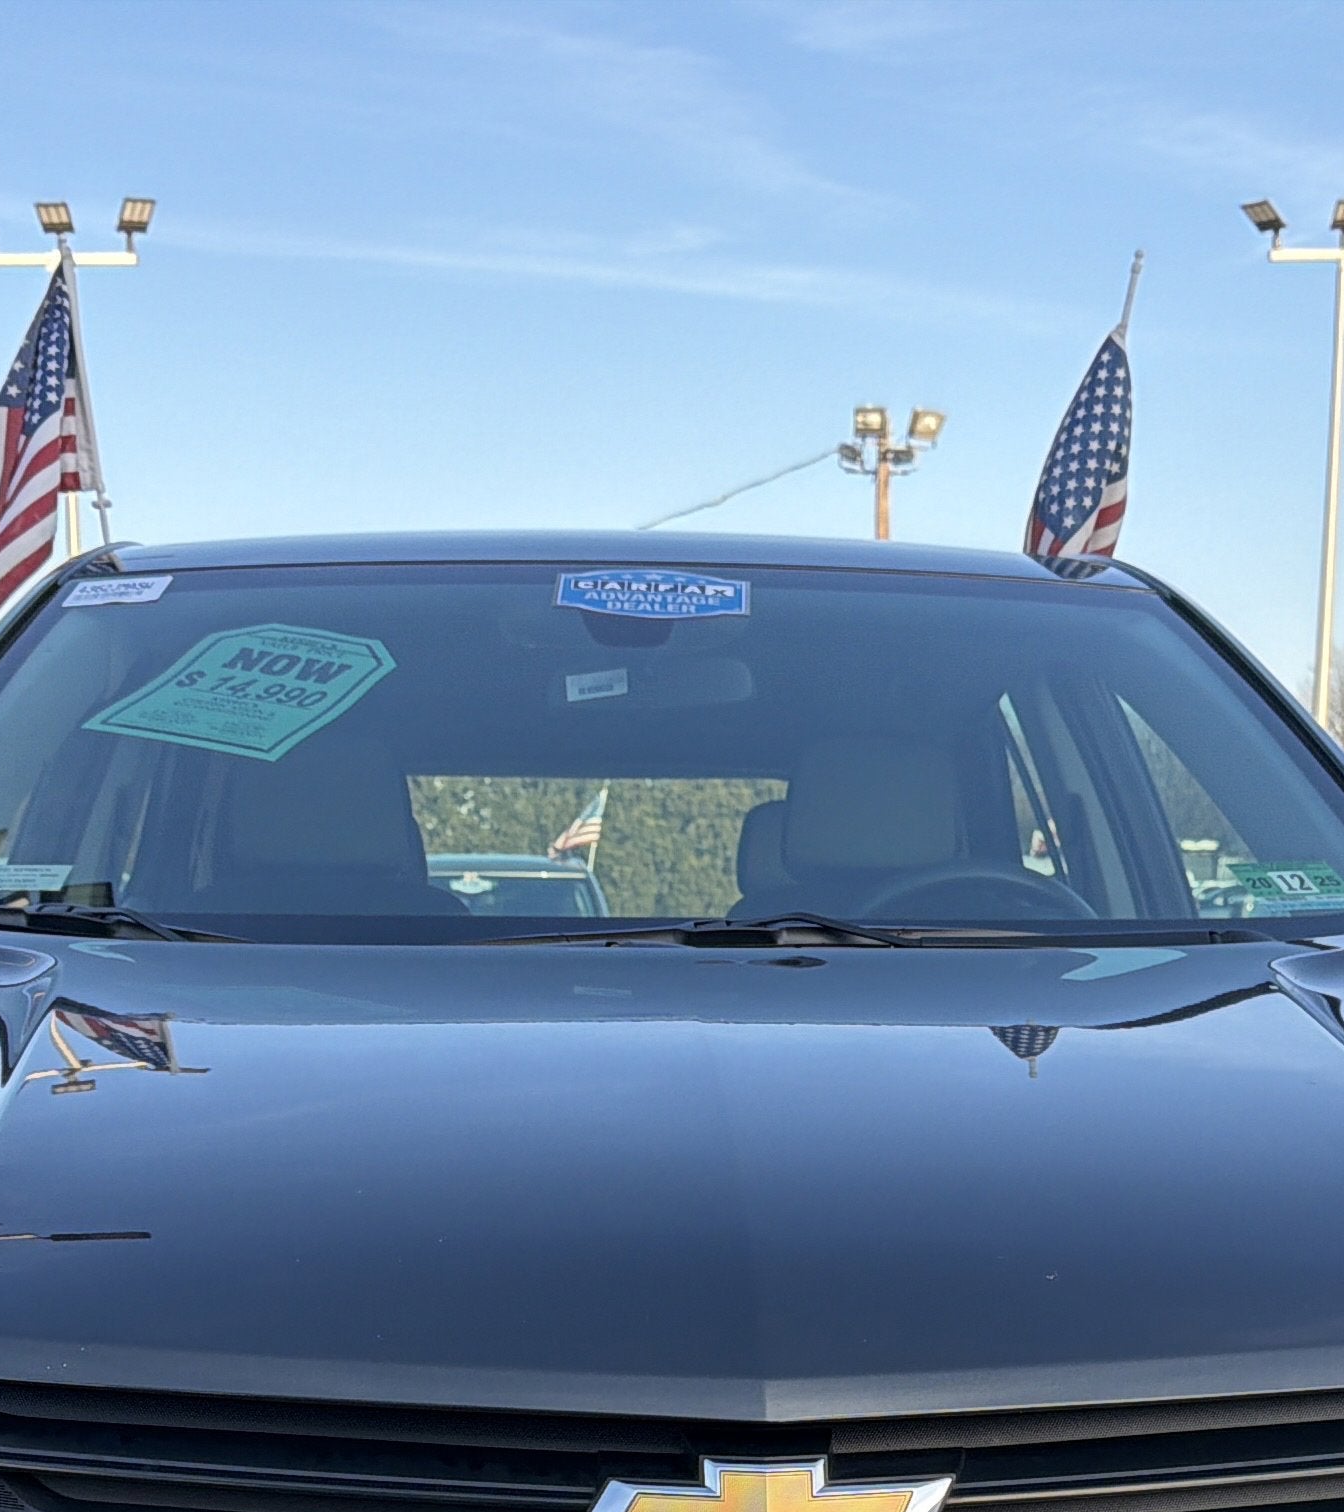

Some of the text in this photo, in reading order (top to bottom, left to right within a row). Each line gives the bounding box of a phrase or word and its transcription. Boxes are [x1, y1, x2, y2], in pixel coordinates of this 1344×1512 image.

[574, 579, 734, 597] CARFAX
[584, 591, 721, 606] ADVANTAGE
[606, 601, 697, 614] DEALER
[220, 646, 354, 685] NOW
[1246, 876, 1272, 890] 20
[1275, 873, 1314, 892] 12
